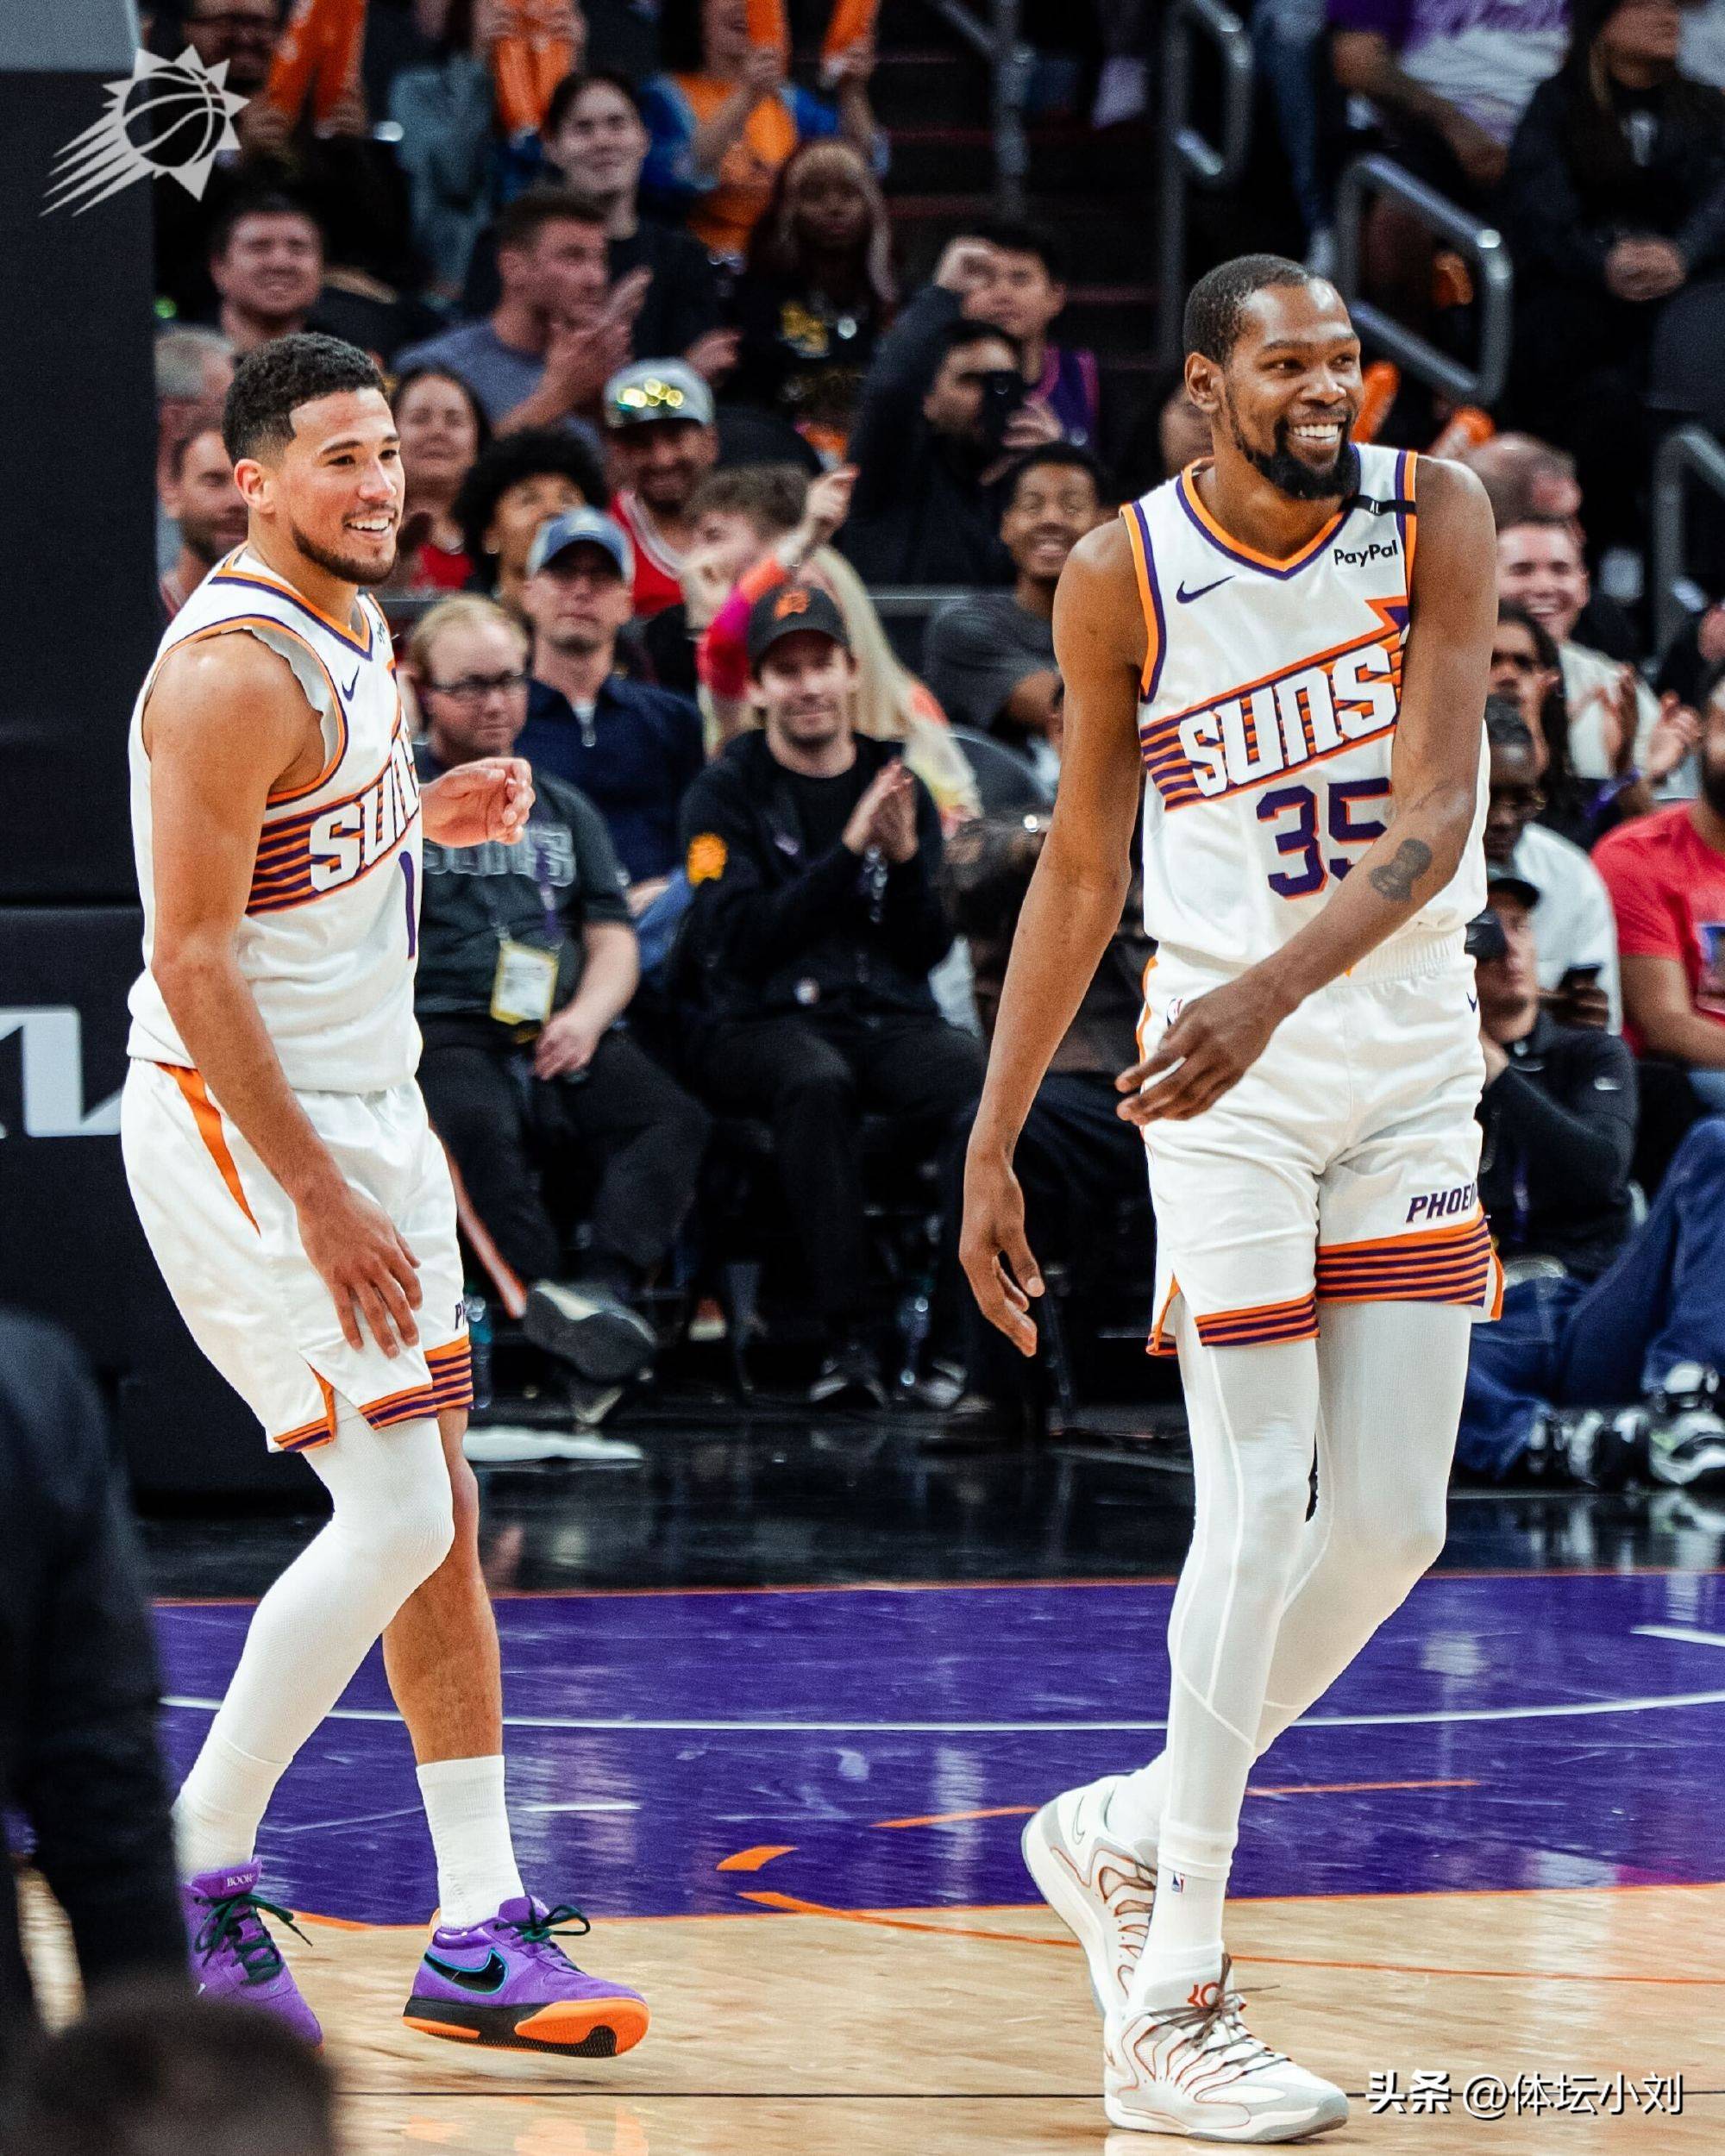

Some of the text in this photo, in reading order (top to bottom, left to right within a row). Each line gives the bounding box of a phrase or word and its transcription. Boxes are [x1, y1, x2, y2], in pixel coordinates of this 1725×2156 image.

[1333, 539, 1398, 567] PayPal
[1177, 642, 1397, 798] SUNS
[1256, 776, 1393, 901] 35
[398, 850, 416, 960] 1
